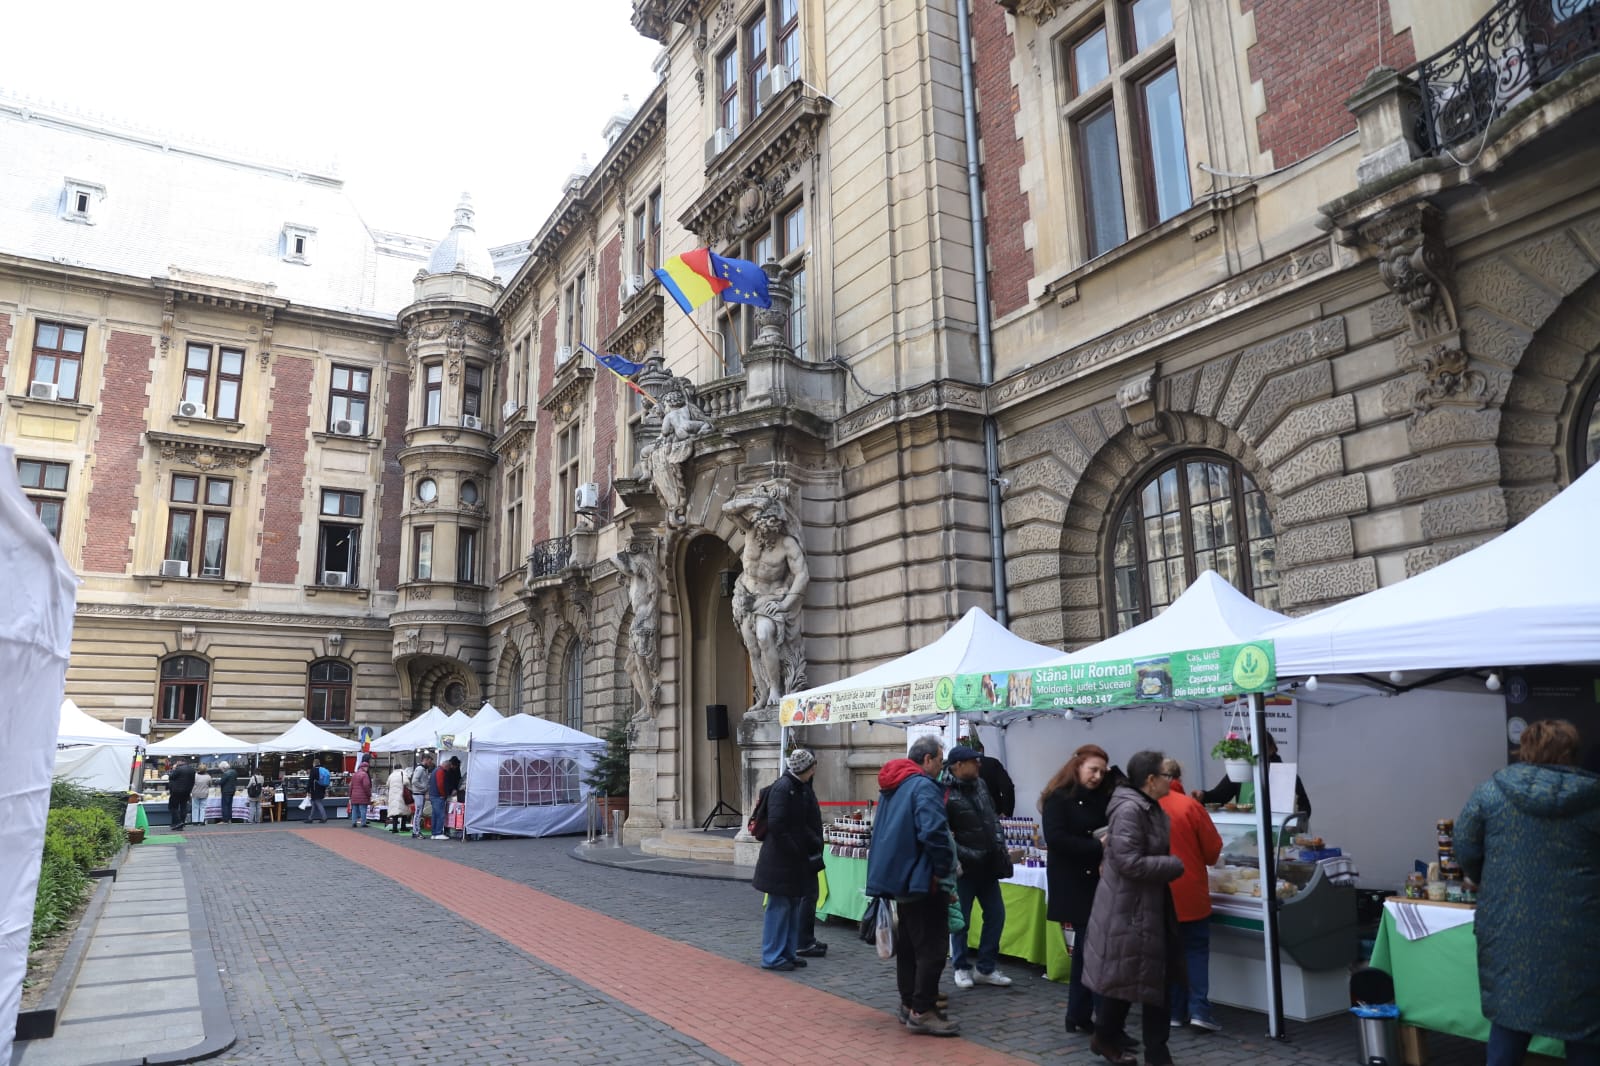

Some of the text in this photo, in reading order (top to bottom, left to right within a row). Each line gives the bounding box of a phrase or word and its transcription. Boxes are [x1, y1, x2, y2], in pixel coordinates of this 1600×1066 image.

[1036, 663, 1132, 682] Stâna lui Roman
[1190, 664, 1219, 673] Telemea
[1098, 679, 1131, 691] Suceava
[1174, 687, 1187, 697] Din
[1187, 686, 1205, 697] lapte
[1206, 684, 1217, 694] de
